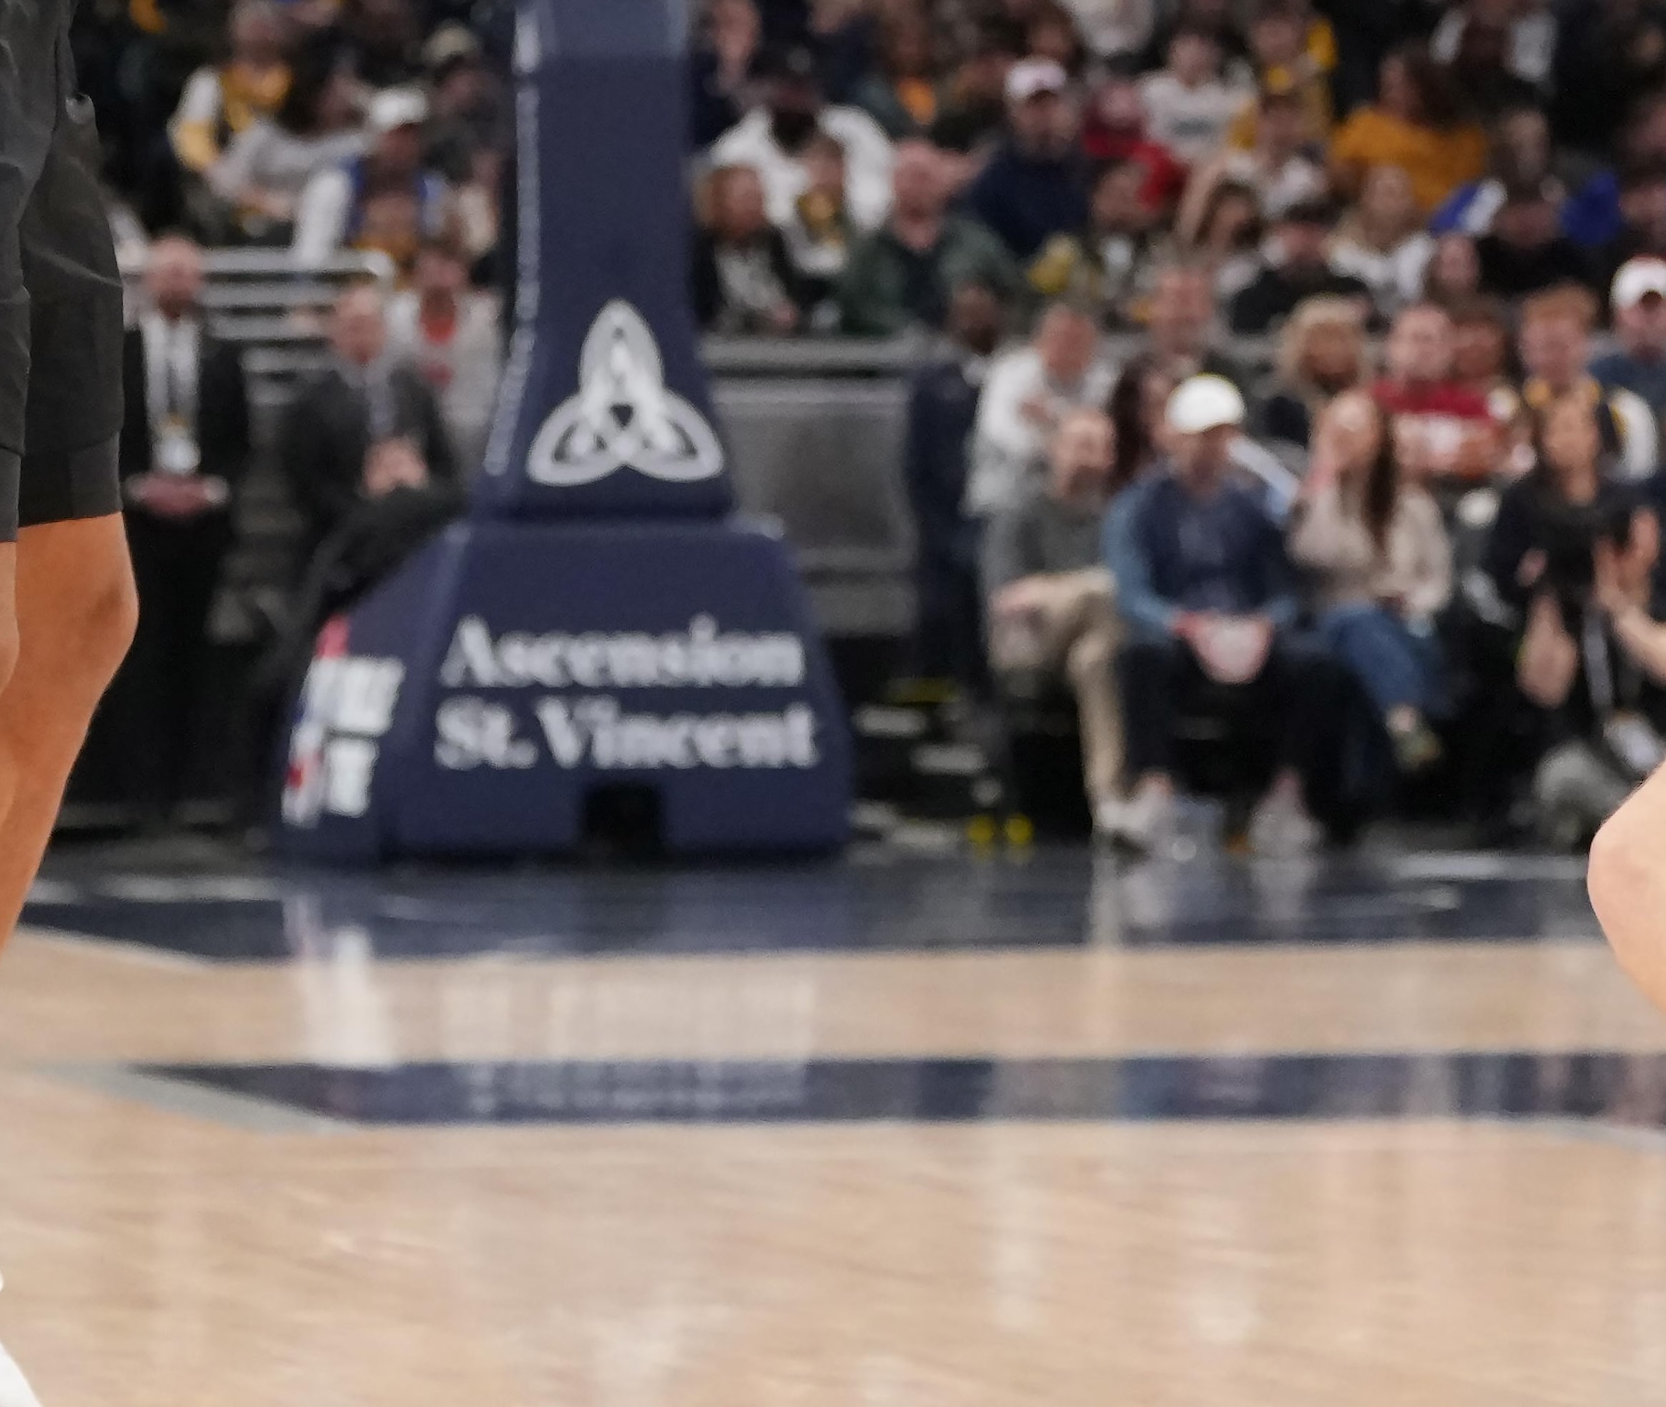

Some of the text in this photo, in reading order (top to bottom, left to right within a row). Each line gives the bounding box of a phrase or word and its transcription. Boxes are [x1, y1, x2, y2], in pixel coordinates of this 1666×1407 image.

[440, 612, 807, 688] Ascension
[435, 694, 537, 770] St.
[535, 694, 821, 770] Vincent
